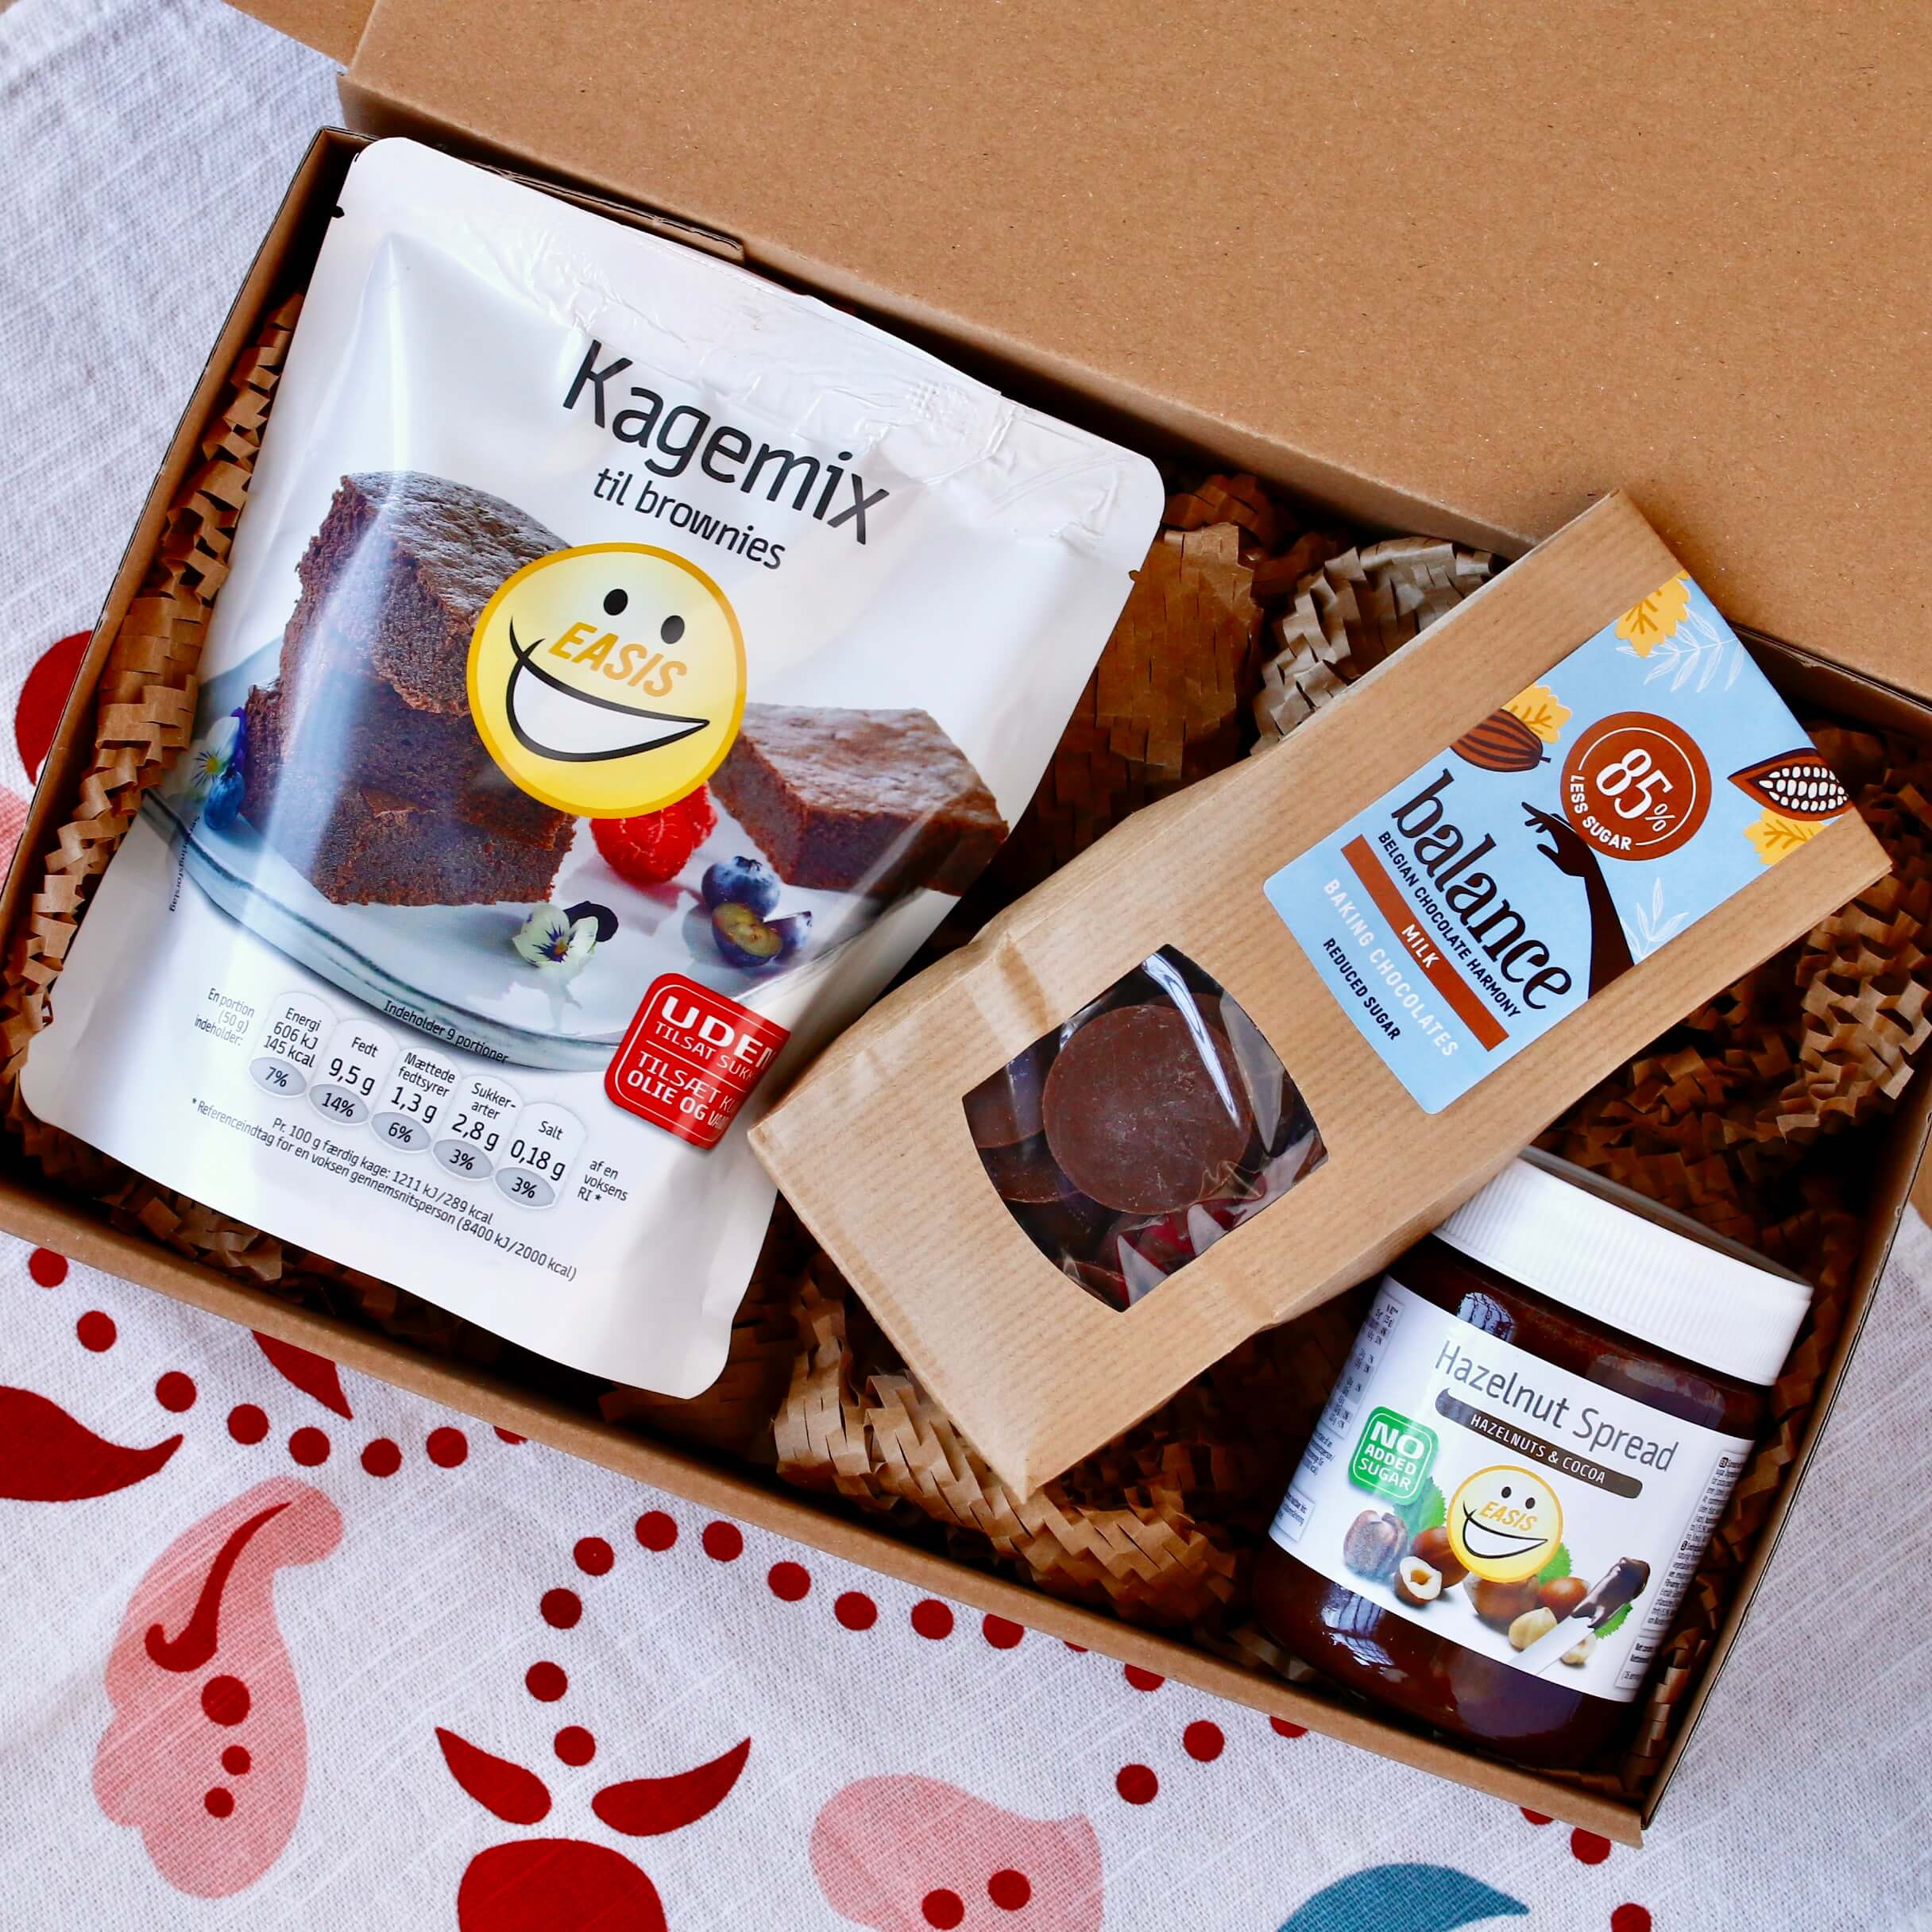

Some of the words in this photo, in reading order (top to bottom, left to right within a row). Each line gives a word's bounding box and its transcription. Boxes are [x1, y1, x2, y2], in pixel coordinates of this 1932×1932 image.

[562, 339, 890, 545] Kagemix
[593, 468, 633, 506] til
[636, 481, 785, 570] brownies
[548, 622, 687, 697] EASIS
[1595, 748, 1676, 832] 85%
[1570, 775, 1589, 814] LESS
[1582, 816, 1633, 851] SUGAR
[1391, 768, 1572, 1010] balance
[1378, 831, 1419, 887] BELGIAN
[1414, 886, 1471, 960] CHOCOLATE
[1466, 957, 1520, 1018] HARMONY
[1401, 923, 1440, 968] MILK
[1323, 878, 1374, 947] BAKING
[1369, 948, 1459, 1056] CHOCOLATES
[207, 987, 220, 1002] En
[219, 994, 255, 1018] portion
[1323, 937, 1369, 998] REDUCED
[1363, 995, 1401, 1041] SUGAR
[194, 1014, 244, 1046] indeholder:
[218, 1009, 238, 1029] (50
[236, 1019, 249, 1034] g)
[273, 1022, 300, 1042] 606
[301, 1033, 319, 1050] kJ
[285, 1007, 322, 1033] Energi
[383, 1000, 446, 1035] Indeholder
[446, 1028, 456, 1040] 9
[455, 1034, 509, 1064] portioner
[263, 1034, 286, 1055] 145
[288, 1045, 316, 1068] kcal
[351, 1036, 378, 1058] Fedt
[655, 1022, 717, 1060] TILSAT
[265, 1066, 290, 1088] 7%
[329, 1057, 361, 1085] 9,5
[360, 1077, 376, 1096] g
[397, 1066, 450, 1098] fedtsyrer
[404, 1052, 456, 1084] Mættede
[637, 1050, 722, 1103] TILSÆT
[322, 1092, 355, 1118] 14%
[391, 1086, 423, 1113] 1,3
[422, 1105, 438, 1124] g
[471, 1082, 516, 1109] Sukker-
[471, 1101, 500, 1120] arter
[628, 1070, 678, 1105] OLIE
[679, 1095, 709, 1122] OG
[388, 1122, 413, 1143] 6%
[451, 1113, 485, 1140] 2,8
[484, 1132, 500, 1151] g
[538, 1121, 563, 1141] Salt
[272, 1117, 286, 1133] Pr.
[288, 1125, 312, 1144] 100
[311, 1138, 321, 1150] g
[323, 1140, 359, 1167] færdig
[359, 1156, 392, 1179] kage:
[392, 1170, 422, 1192] 1211
[468, 1204, 494, 1225] kcal
[449, 1149, 476, 1171] 3%
[510, 1139, 551, 1170] 0,18
[550, 1161, 566, 1181] g
[589, 1160, 605, 1172] af
[603, 1165, 619, 1180] en
[511, 1177, 538, 1199] 3%
[583, 1174, 628, 1202] voksens
[276, 1136, 295, 1153] for
[295, 1146, 310, 1161] en
[311, 1152, 350, 1177] voksen
[350, 1171, 456, 1226] gennemsnitsperson
[455, 1216, 494, 1242] (8400
[547, 1258, 578, 1282] kcal)
[1435, 1339, 1570, 1429] Hazelnut
[1572, 1407, 1679, 1472] Spread
[1364, 1443, 1417, 1475] ADDED
[1370, 1420, 1424, 1460] NO
[1470, 1414, 1546, 1458] HAZELNUTS
[1548, 1450, 1559, 1464] &
[1562, 1457, 1606, 1484] COCOA
[1358, 1458, 1411, 1491] SUGAR
[1478, 1501, 1539, 1532] EASIS
